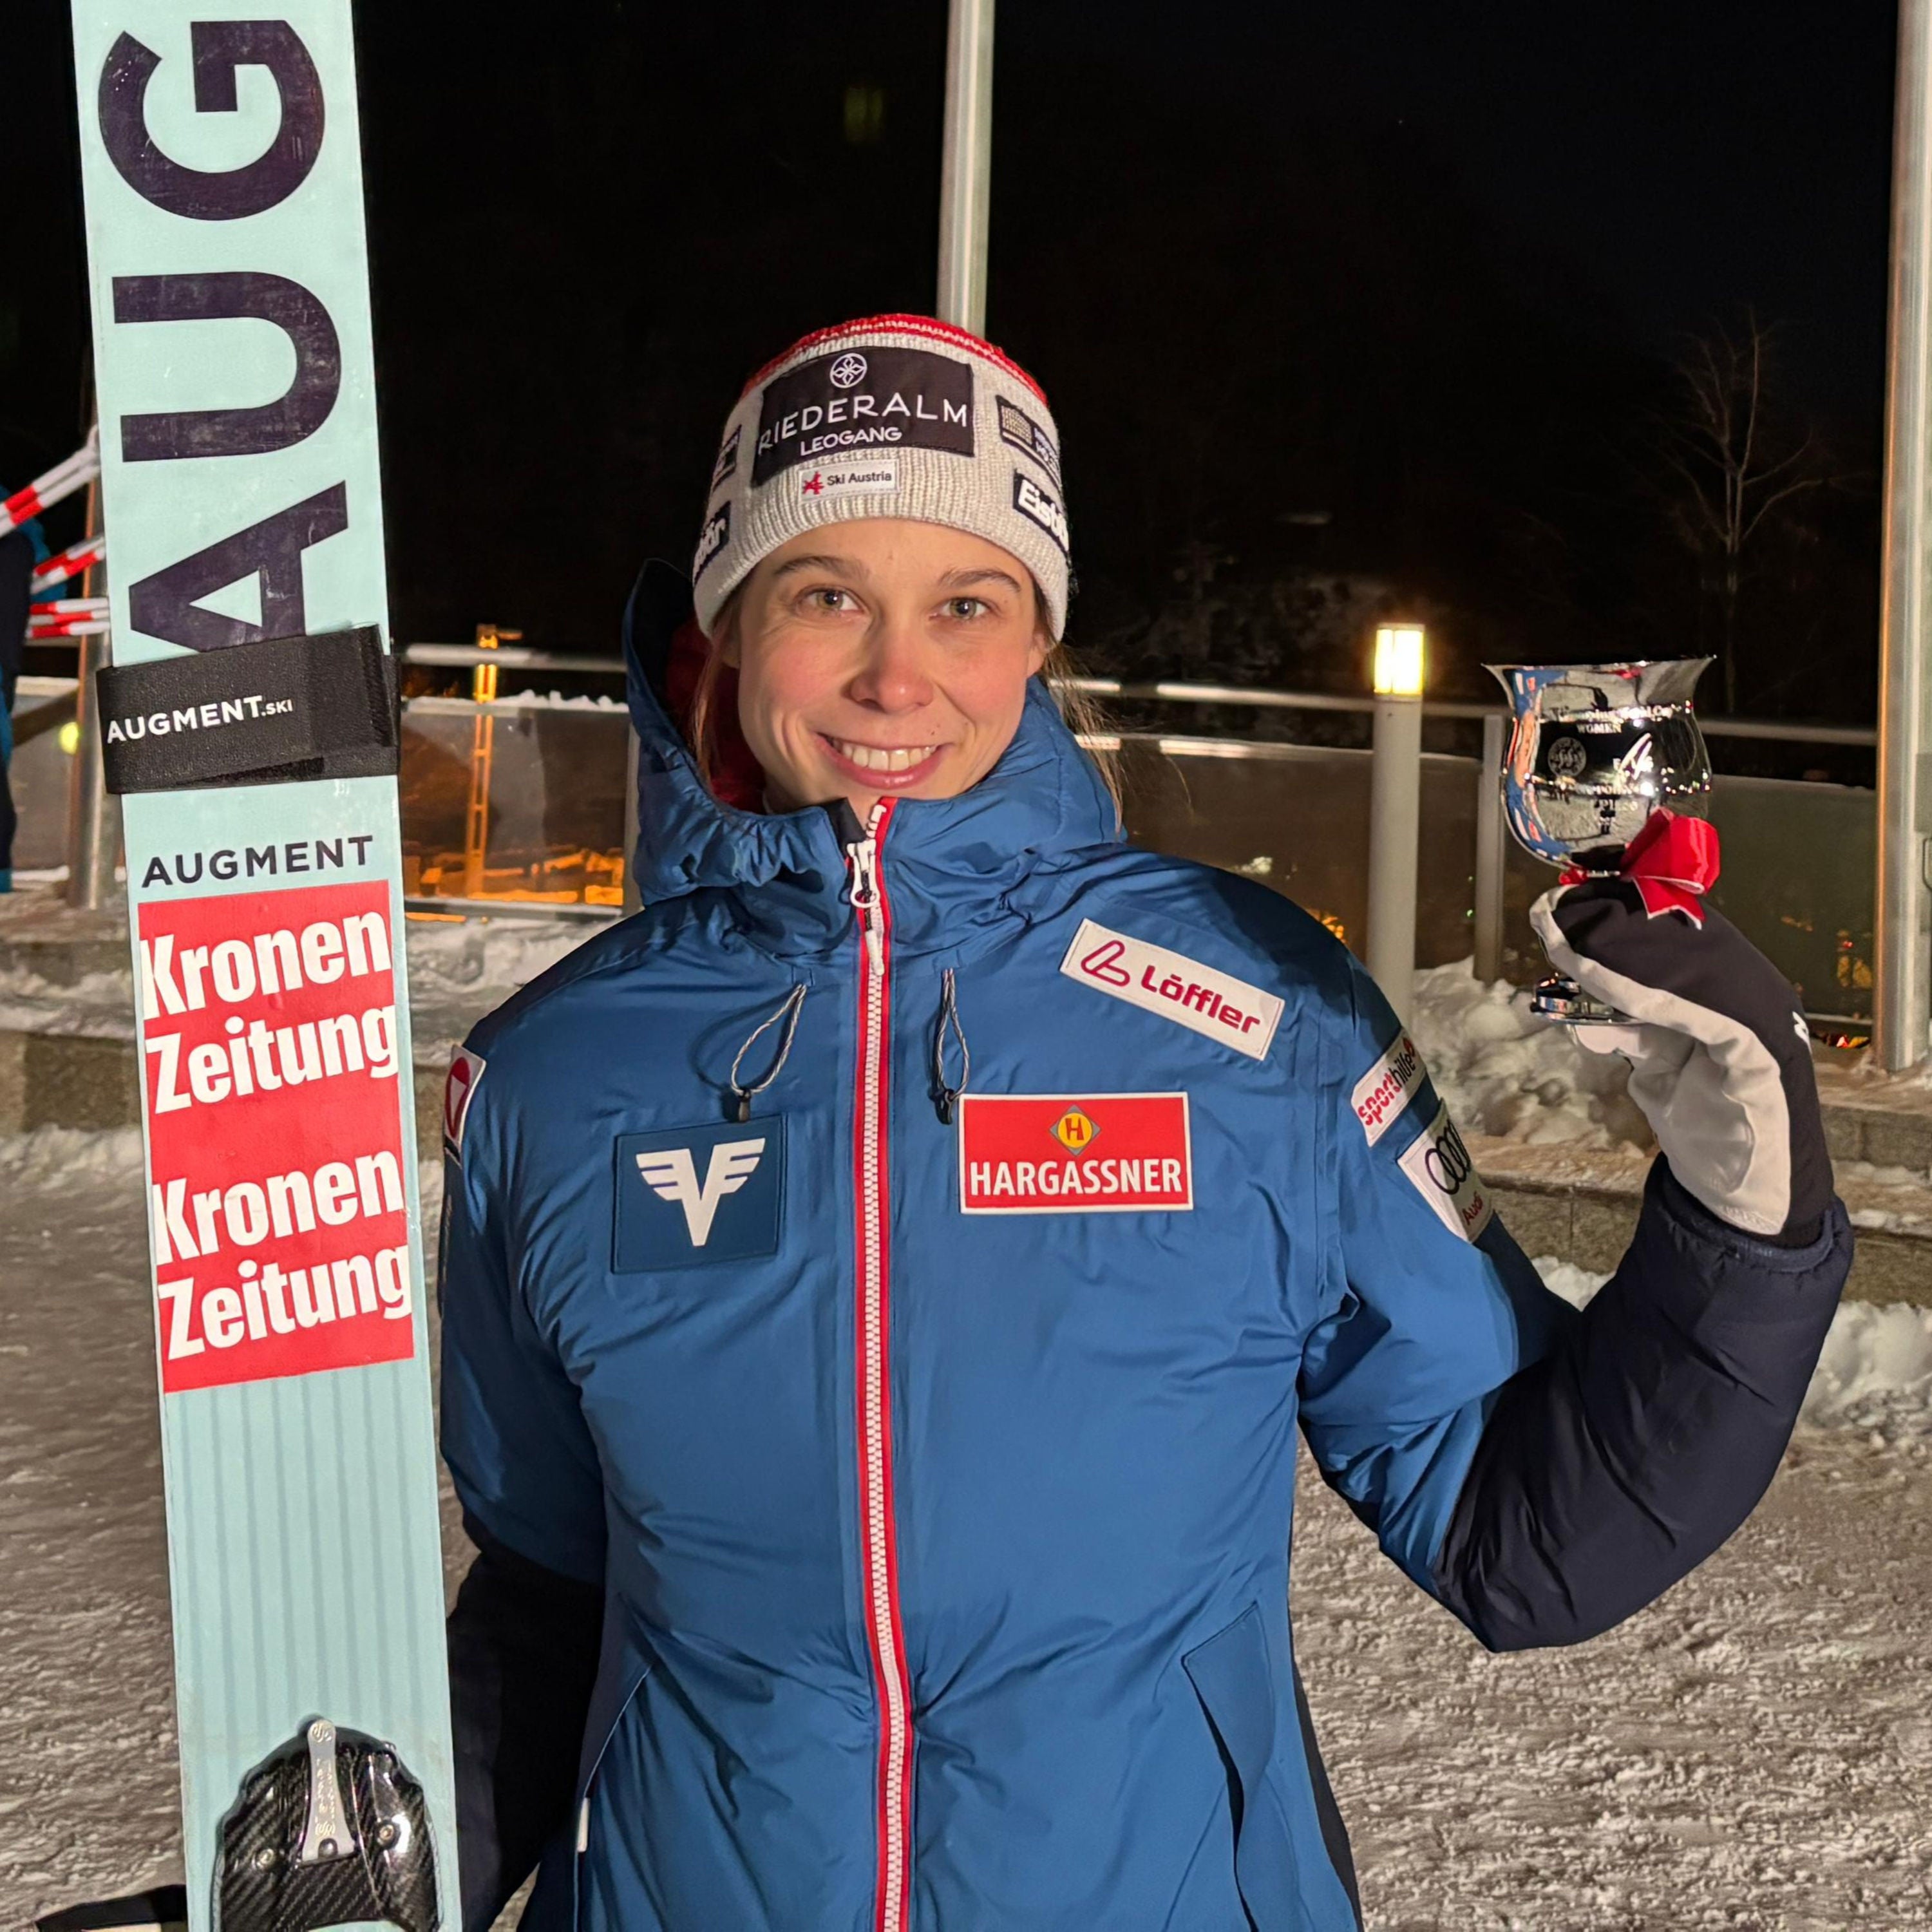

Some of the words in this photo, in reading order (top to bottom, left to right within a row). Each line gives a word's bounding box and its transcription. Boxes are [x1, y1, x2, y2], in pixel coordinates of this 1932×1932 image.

[758, 392, 967, 455] RIEDERALM
[800, 426, 902, 456] LEOGANG
[827, 475, 845, 486] Ski
[848, 471, 892, 484] Austria
[107, 696, 293, 744] AUGMENT.SKI
[141, 835, 374, 888] AUGMENT
[138, 909, 392, 1020] Kronen
[1141, 965, 1260, 1034] Löffler
[144, 1004, 399, 1115] Zeitung
[1065, 1117, 1084, 1141] H
[970, 1159, 1182, 1196] HARGASSNER
[152, 1149, 405, 1265] Kronen
[157, 1244, 413, 1361] Zeitung
